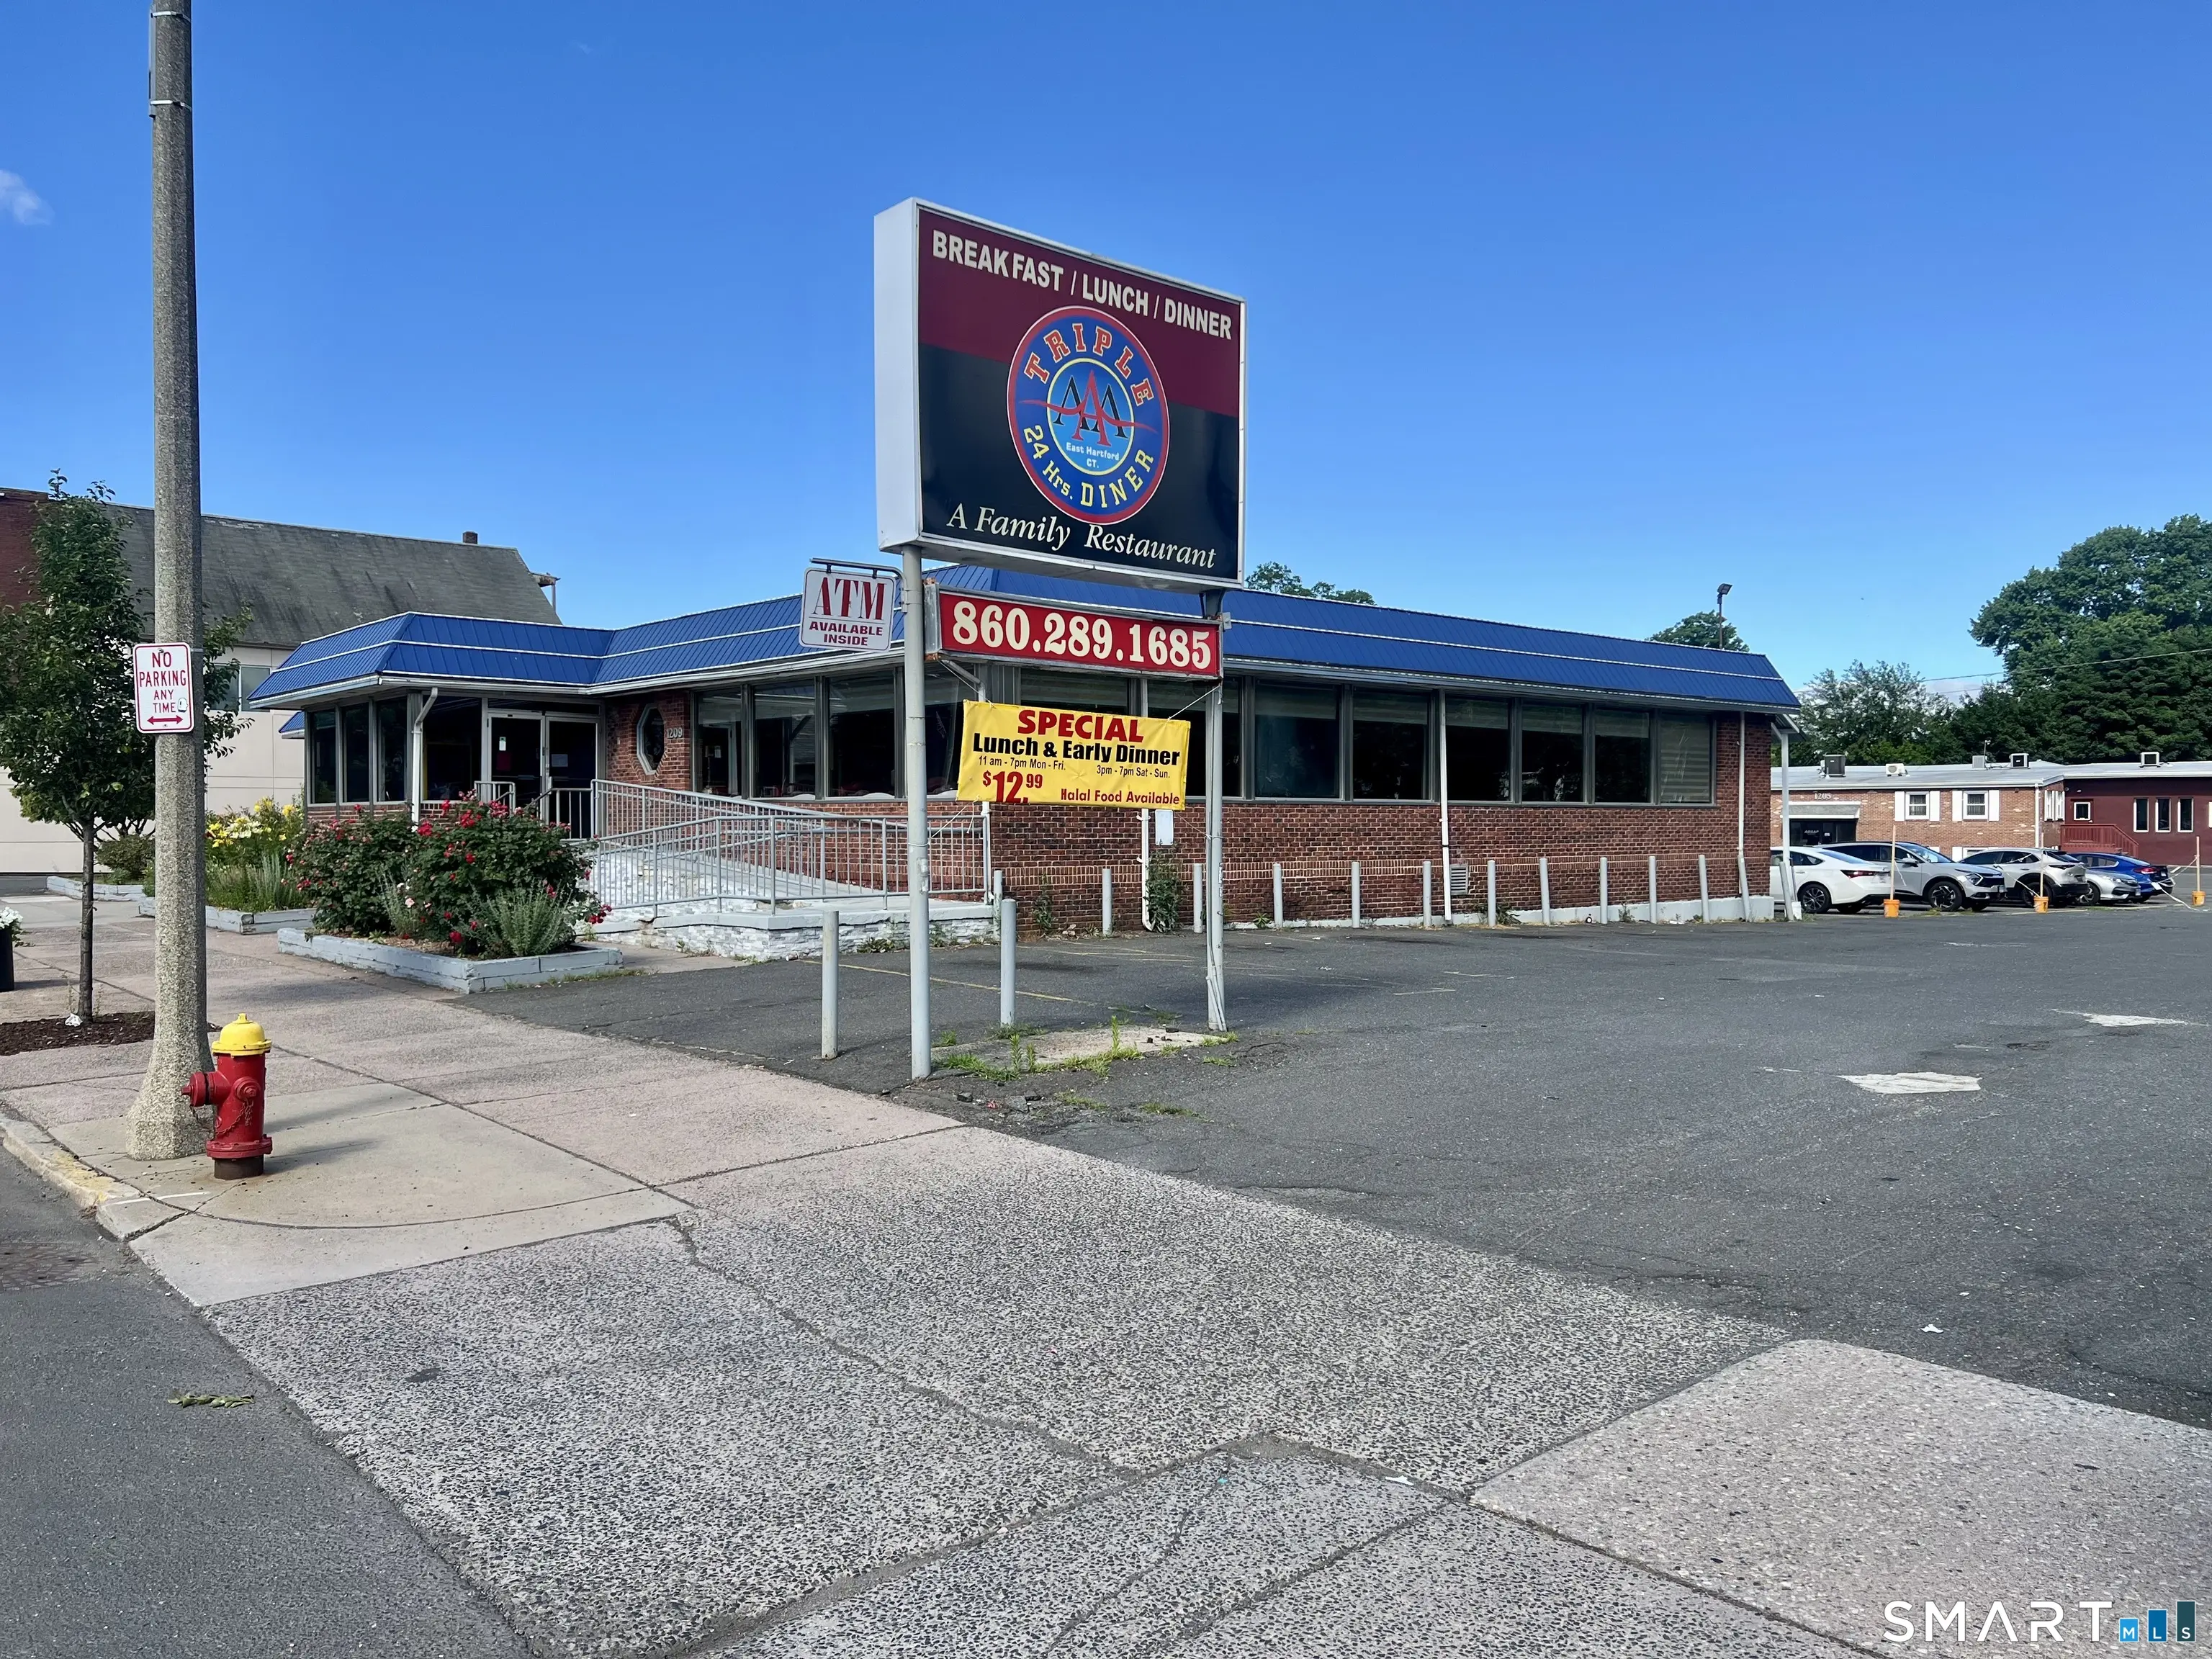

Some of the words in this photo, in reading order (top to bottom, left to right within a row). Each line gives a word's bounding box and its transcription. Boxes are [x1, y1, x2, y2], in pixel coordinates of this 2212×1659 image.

[932, 230, 1064, 292] BREAKFAST
[1082, 274, 1148, 317] LUNCH
[1164, 298, 1232, 340] DINNER
[1023, 323, 1155, 406] TRIPLE
[1066, 441, 1084, 454] East
[1086, 446, 1120, 461] Hartford
[1023, 424, 1050, 460] 24
[1043, 459, 1074, 500] Hrs.
[1087, 458, 1100, 469] CT.
[1080, 449, 1154, 508] DINER
[945, 503, 968, 530] A
[974, 506, 1071, 552] Family
[1084, 524, 1217, 569] Restaurant
[810, 577, 888, 621] ATM
[809, 621, 884, 636] AVAILABLE
[953, 601, 1212, 670] 860.289.1685
[823, 634, 868, 646] INSIDE
[151, 652, 172, 667] NO
[139, 670, 186, 687] PARKING
[153, 689, 174, 701] ANY
[153, 702, 176, 713] TIME
[667, 727, 683, 739] 1209
[1017, 709, 1143, 743] SPECIAL
[973, 732, 1038, 757] Lunch
[1043, 741, 1058, 757] &
[1063, 740, 1112, 763] Early
[1116, 745, 1180, 765] Dinner
[979, 756, 987, 766] 11
[989, 758, 1002, 767] am
[1010, 757, 1027, 770] 7pm
[1029, 759, 1046, 769] Mon
[1053, 760, 1066, 770] Fri.
[1097, 765, 1112, 777] 3pm
[1119, 765, 1134, 778] 7pm
[1136, 766, 1148, 777] Sat
[1154, 768, 1170, 778] Sun.
[1061, 788, 1091, 801] Halal
[1094, 790, 1122, 802] Food
[1125, 789, 1180, 804] Available
